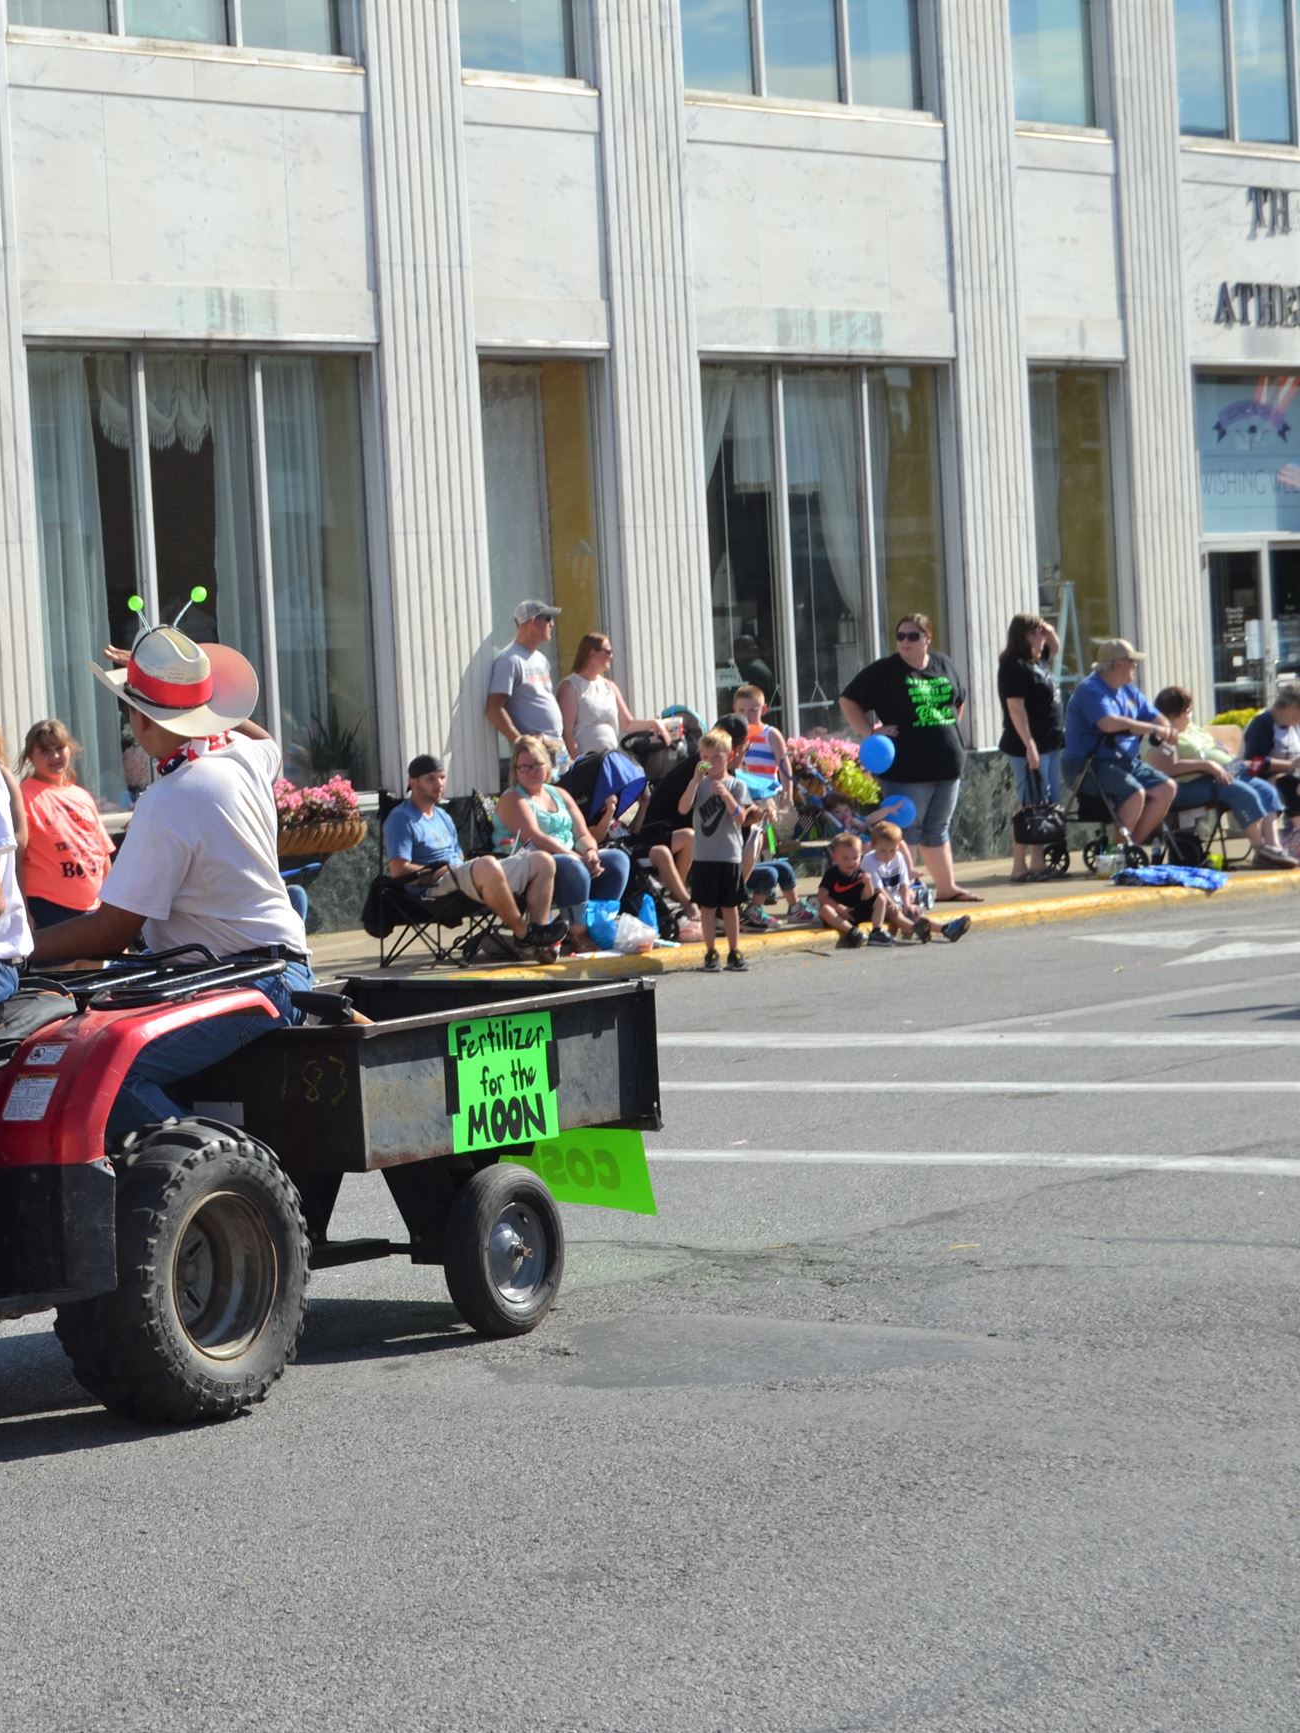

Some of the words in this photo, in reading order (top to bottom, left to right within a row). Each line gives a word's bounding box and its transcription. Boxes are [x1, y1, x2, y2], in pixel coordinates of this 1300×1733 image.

[1214, 282, 1300, 328] ATHE
[456, 1019, 544, 1060] Fertilizer
[480, 1066, 504, 1096] for
[511, 1058, 536, 1091] the
[468, 1093, 546, 1146] MOON
